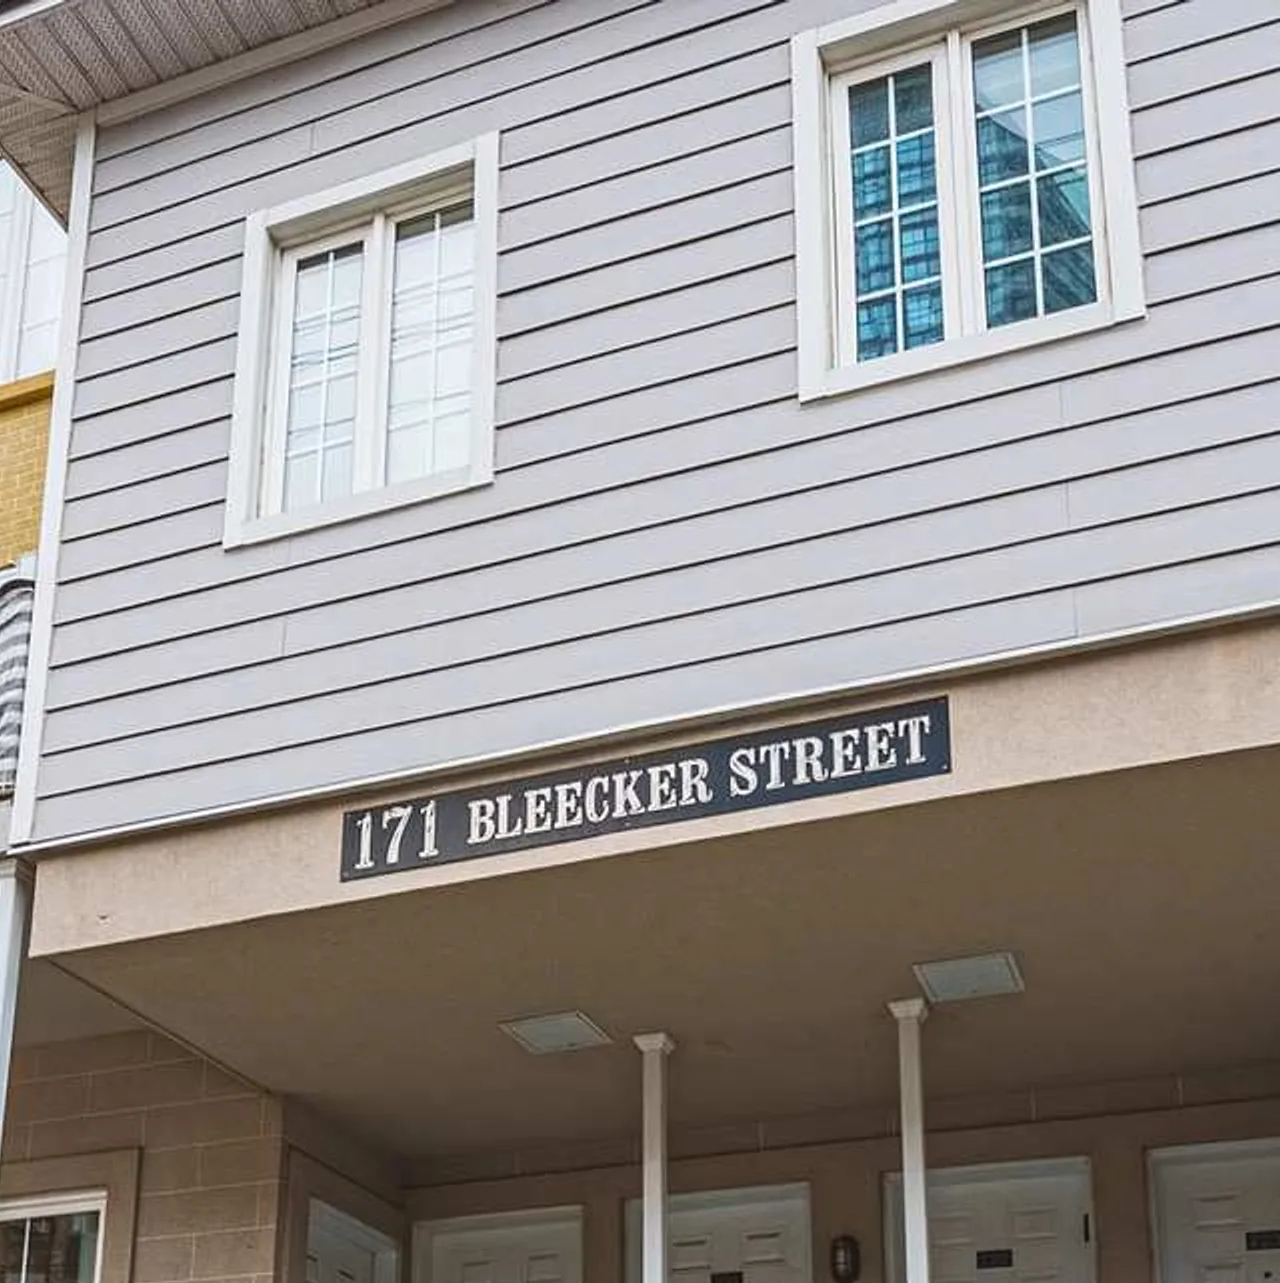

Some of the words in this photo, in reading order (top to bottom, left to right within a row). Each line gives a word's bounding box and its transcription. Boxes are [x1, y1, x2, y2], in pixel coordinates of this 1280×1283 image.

[353, 799, 440, 870] 171
[465, 757, 714, 846] BLEECKER
[728, 714, 932, 799] STREET
